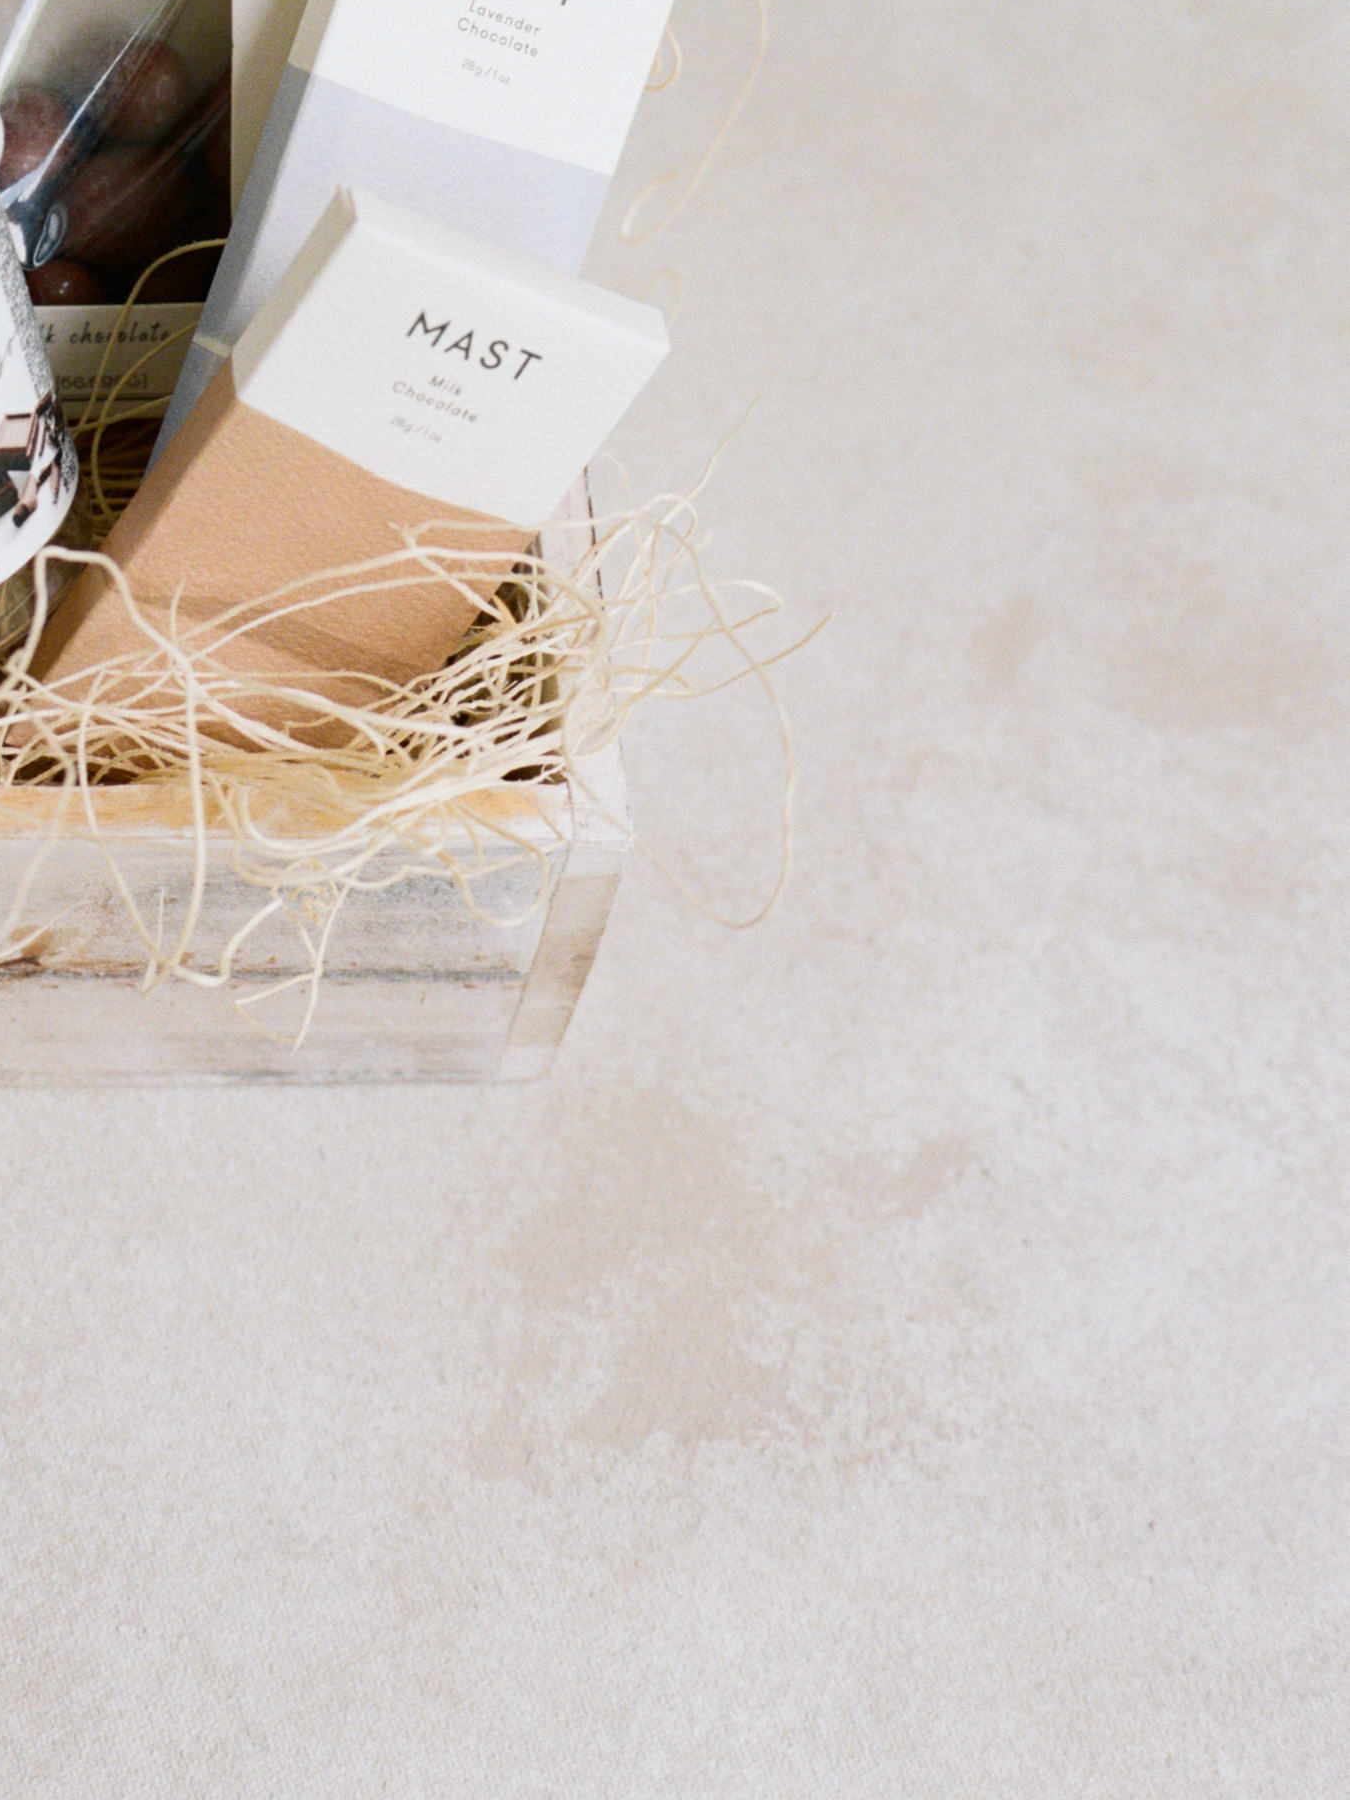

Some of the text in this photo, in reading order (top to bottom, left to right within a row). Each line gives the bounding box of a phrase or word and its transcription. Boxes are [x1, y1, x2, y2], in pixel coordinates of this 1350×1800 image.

[457, 17, 538, 58] Chocolate
[468, 0, 541, 36] Lavender
[406, 309, 542, 381] MAST
[392, 380, 478, 423] Chocolate
[429, 375, 463, 397] Milk
